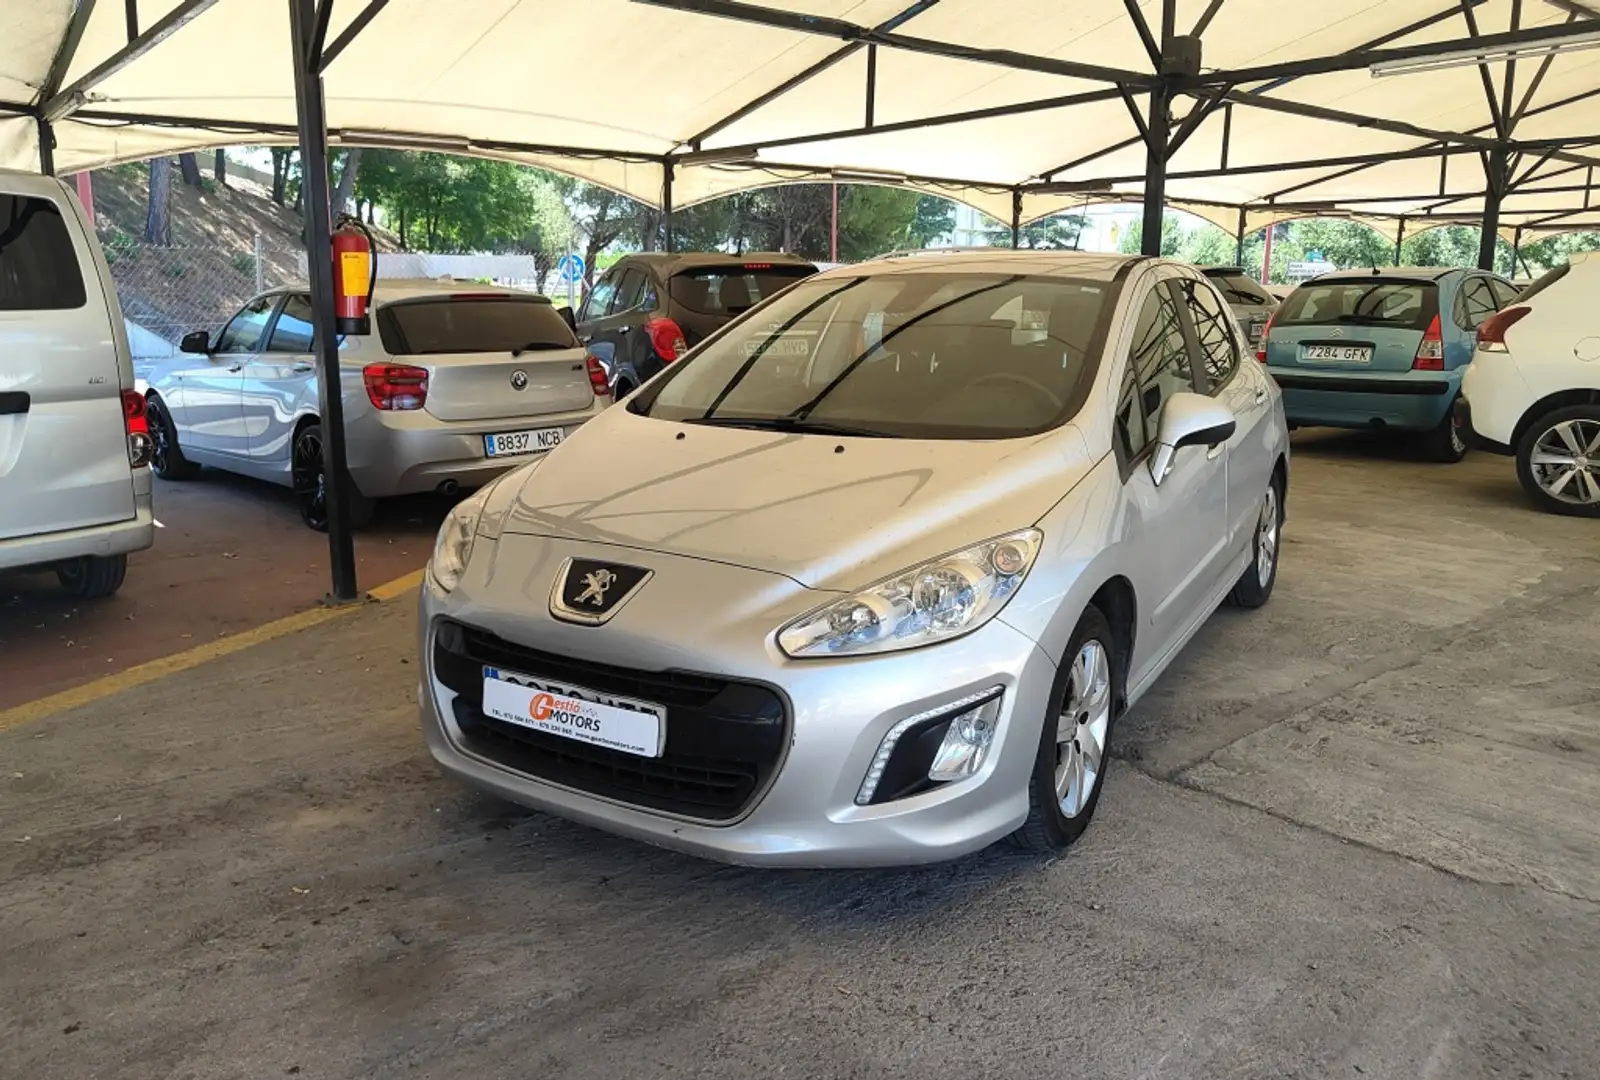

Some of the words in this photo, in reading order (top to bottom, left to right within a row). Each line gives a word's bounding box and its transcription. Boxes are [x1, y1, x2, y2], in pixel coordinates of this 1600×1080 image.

[1309, 346, 1338, 358] 7284
[1344, 348, 1369, 360] GFK
[497, 434, 530, 451] 8837
[537, 431, 561, 447] NCB
[550, 709, 601, 732] MOTORS
